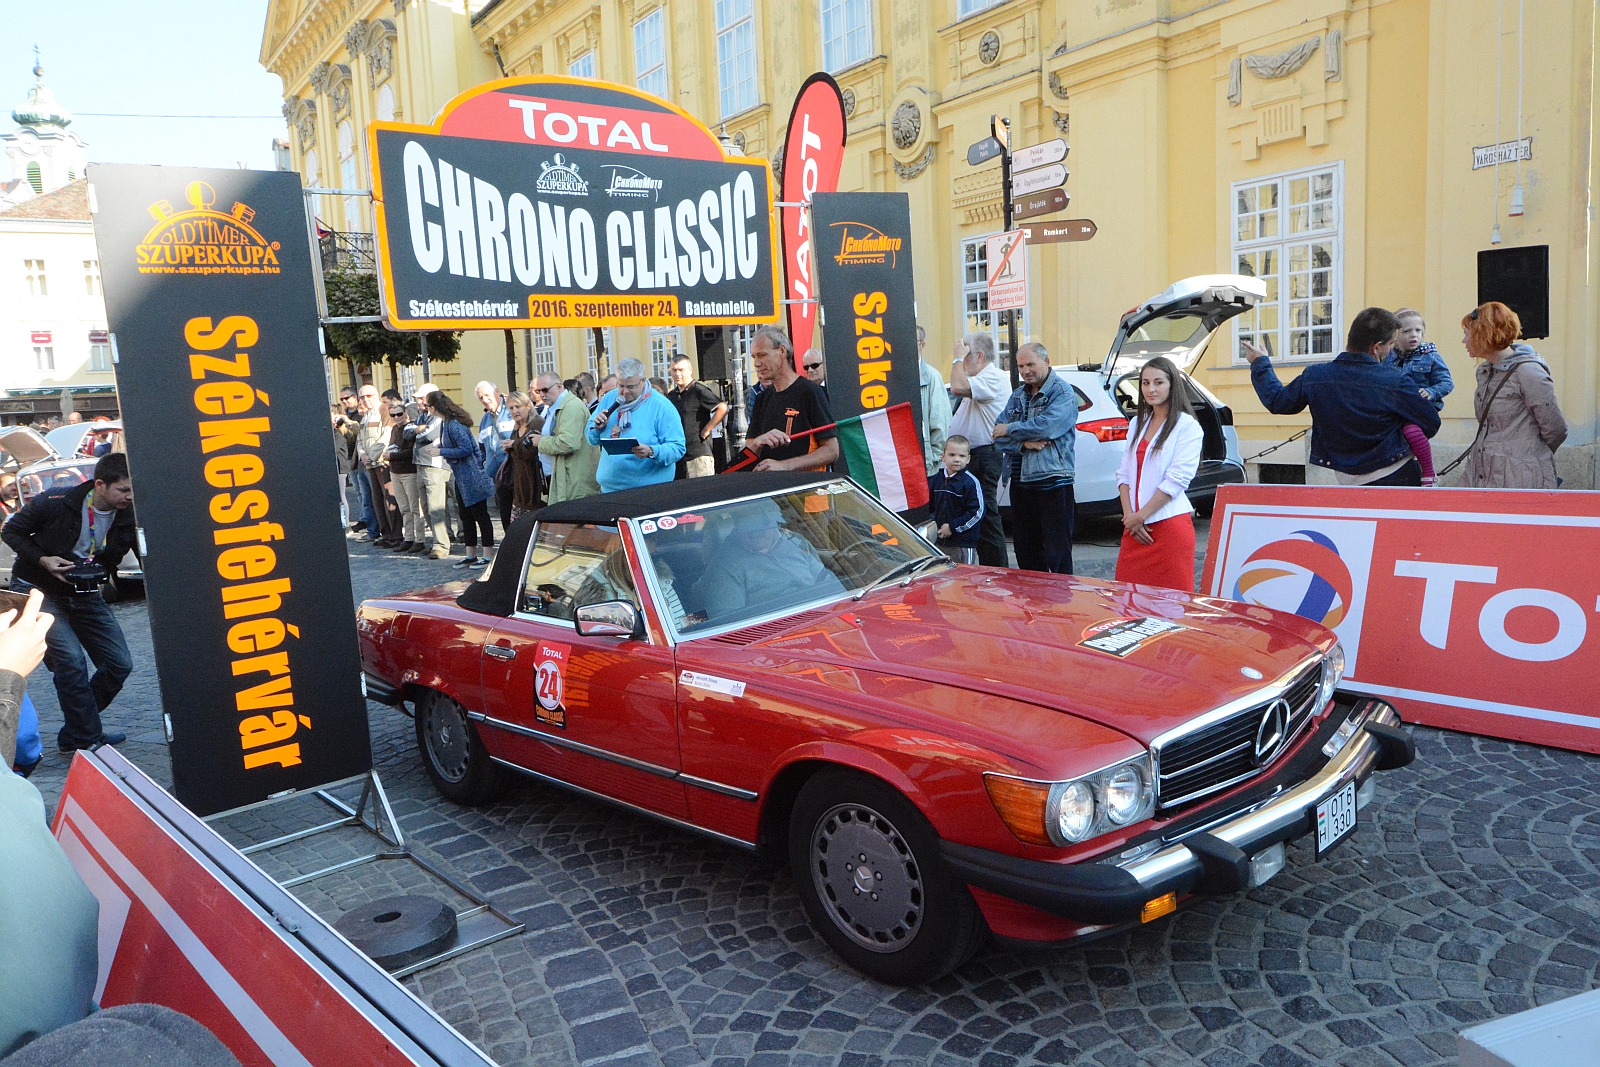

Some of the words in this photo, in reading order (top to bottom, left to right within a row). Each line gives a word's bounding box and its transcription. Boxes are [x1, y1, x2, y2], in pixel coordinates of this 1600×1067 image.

[508, 98, 669, 153] TOTAL
[536, 180, 588, 192] SZUPERKUPA
[403, 140, 598, 291] CHRONO
[605, 170, 758, 291] CLASSIC
[160, 218, 251, 245] OLDTIMER
[1043, 227, 1068, 236] Romkert
[135, 244, 280, 265] SZUPERKUPA
[837, 257, 885, 265] TIMING
[138, 265, 281, 276] www.szuperkupa.hu
[409, 299, 519, 318] Székesfehérvár
[532, 300, 572, 318] 2016.
[575, 300, 654, 320] szeptember
[656, 299, 676, 318] 24.
[685, 299, 755, 316] Balatonlelle
[853, 290, 893, 410] Széke
[183, 314, 312, 770] Székesfehérvár
[542, 646, 563, 660] TOTAL
[539, 667, 558, 701] 24
[1333, 808, 1351, 837] 330
[1319, 826, 1327, 844] H
